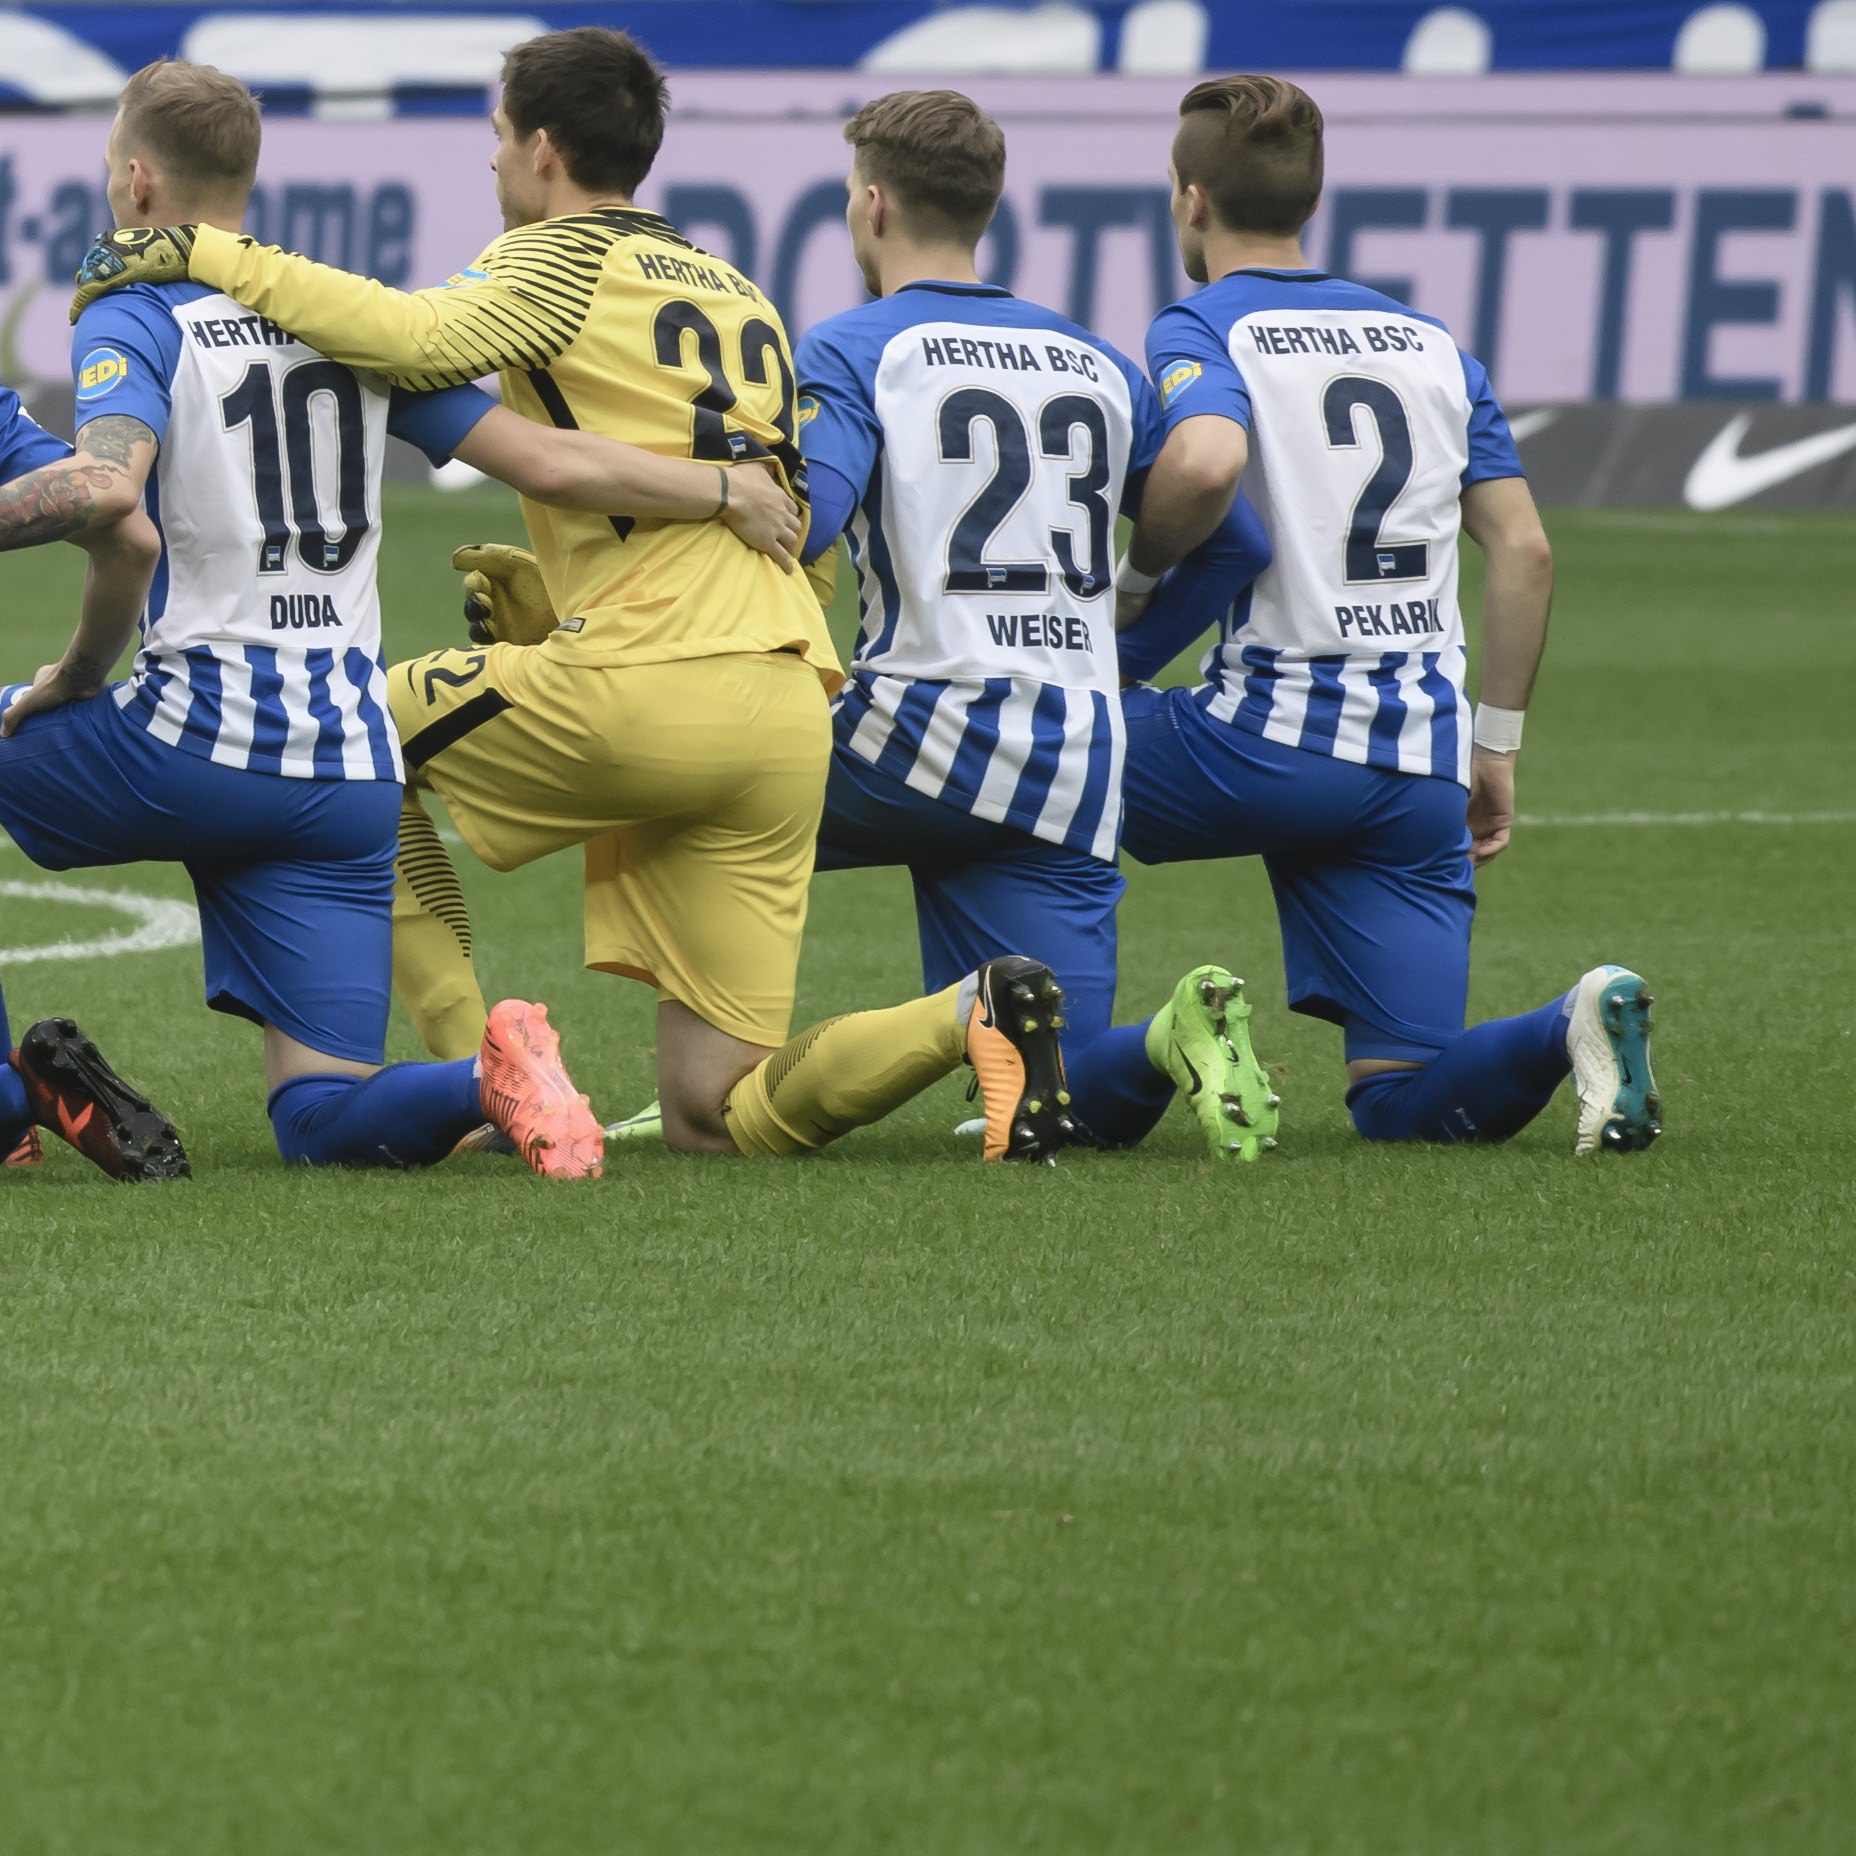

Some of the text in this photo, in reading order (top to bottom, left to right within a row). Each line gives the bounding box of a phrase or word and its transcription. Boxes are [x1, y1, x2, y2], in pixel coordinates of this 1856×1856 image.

[635, 253, 727, 293] HERTHA
[921, 337, 1100, 384] HERTHA BSC
[1247, 325, 1424, 355] HERTHA BSC
[217, 357, 372, 577] 10
[1319, 372, 1431, 586] 2
[934, 384, 1115, 603] 23
[270, 594, 343, 630] DUDA
[1334, 597, 1445, 638] PEKARIK
[986, 613, 1094, 655] WEISER
